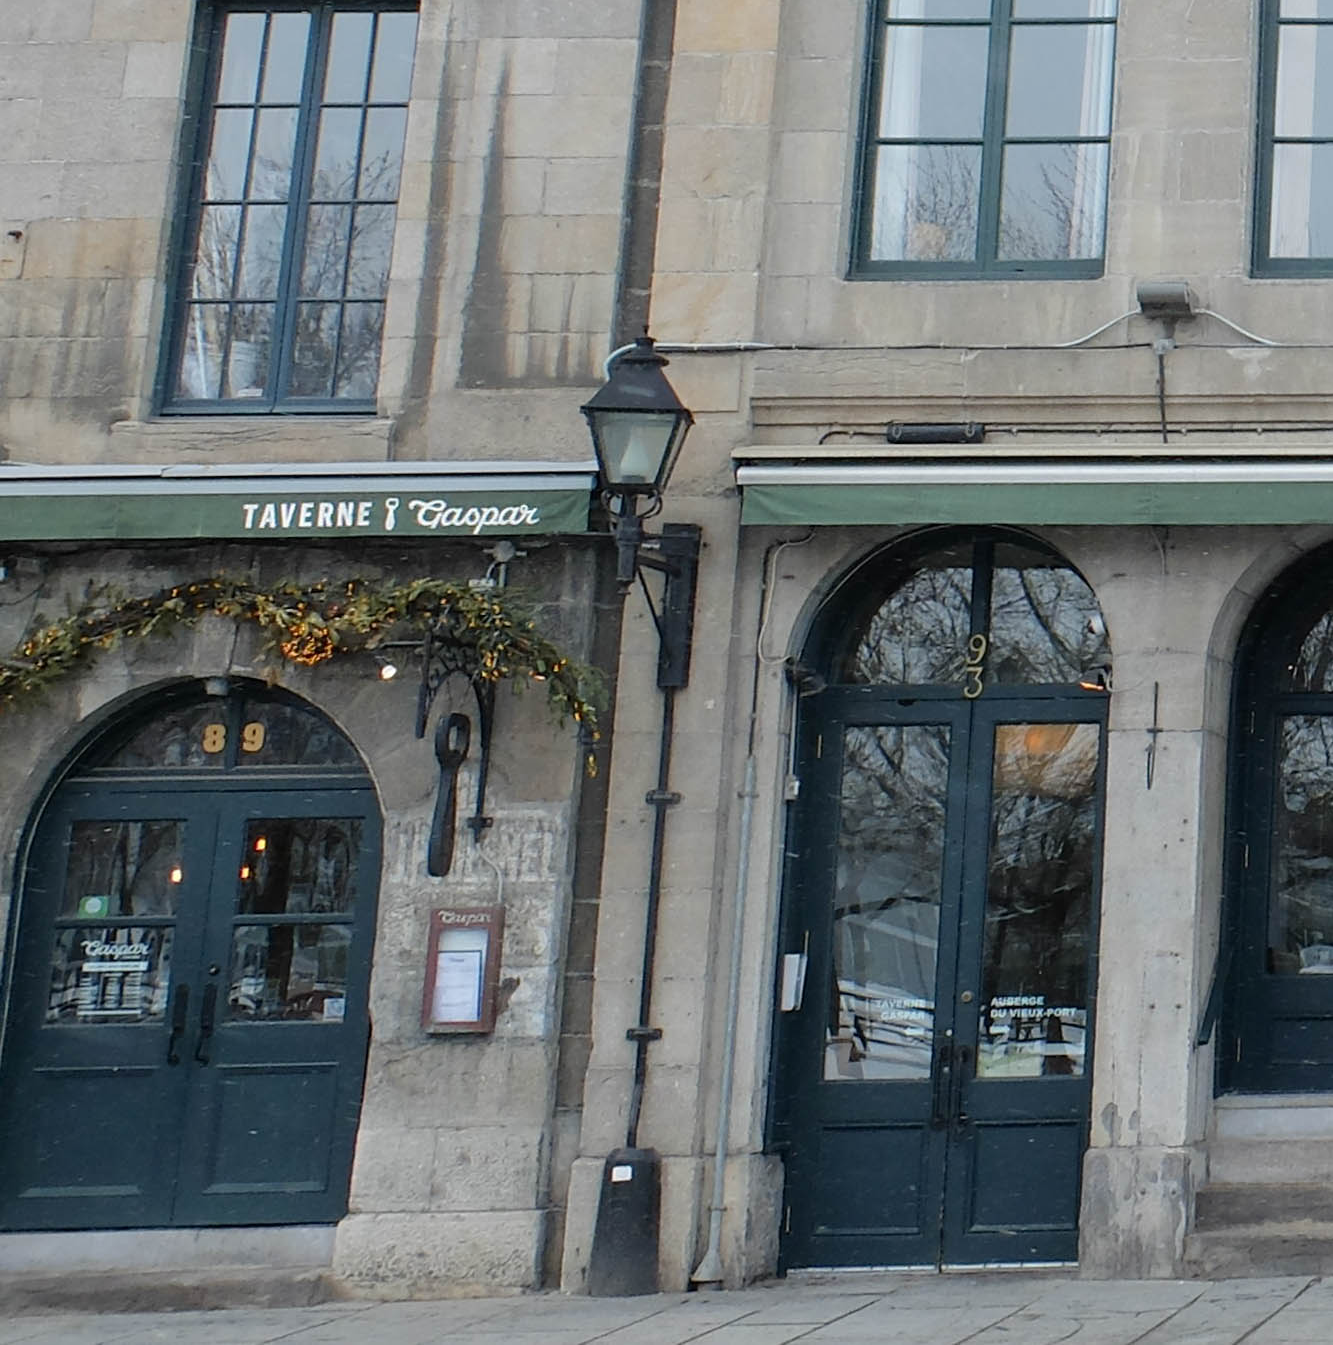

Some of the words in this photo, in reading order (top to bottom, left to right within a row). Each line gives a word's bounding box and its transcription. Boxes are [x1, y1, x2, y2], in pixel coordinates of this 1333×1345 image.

[243, 501, 373, 530] TAVERNE
[408, 499, 540, 535] Gaspar
[963, 634, 987, 699] 93
[202, 722, 265, 753] 89
[81, 939, 149, 960] Gaspar
[990, 995, 1045, 1007] AUBERGE
[990, 1008, 1008, 1018] DU
[1009, 1007, 1077, 1018] VIEUX-PORT
